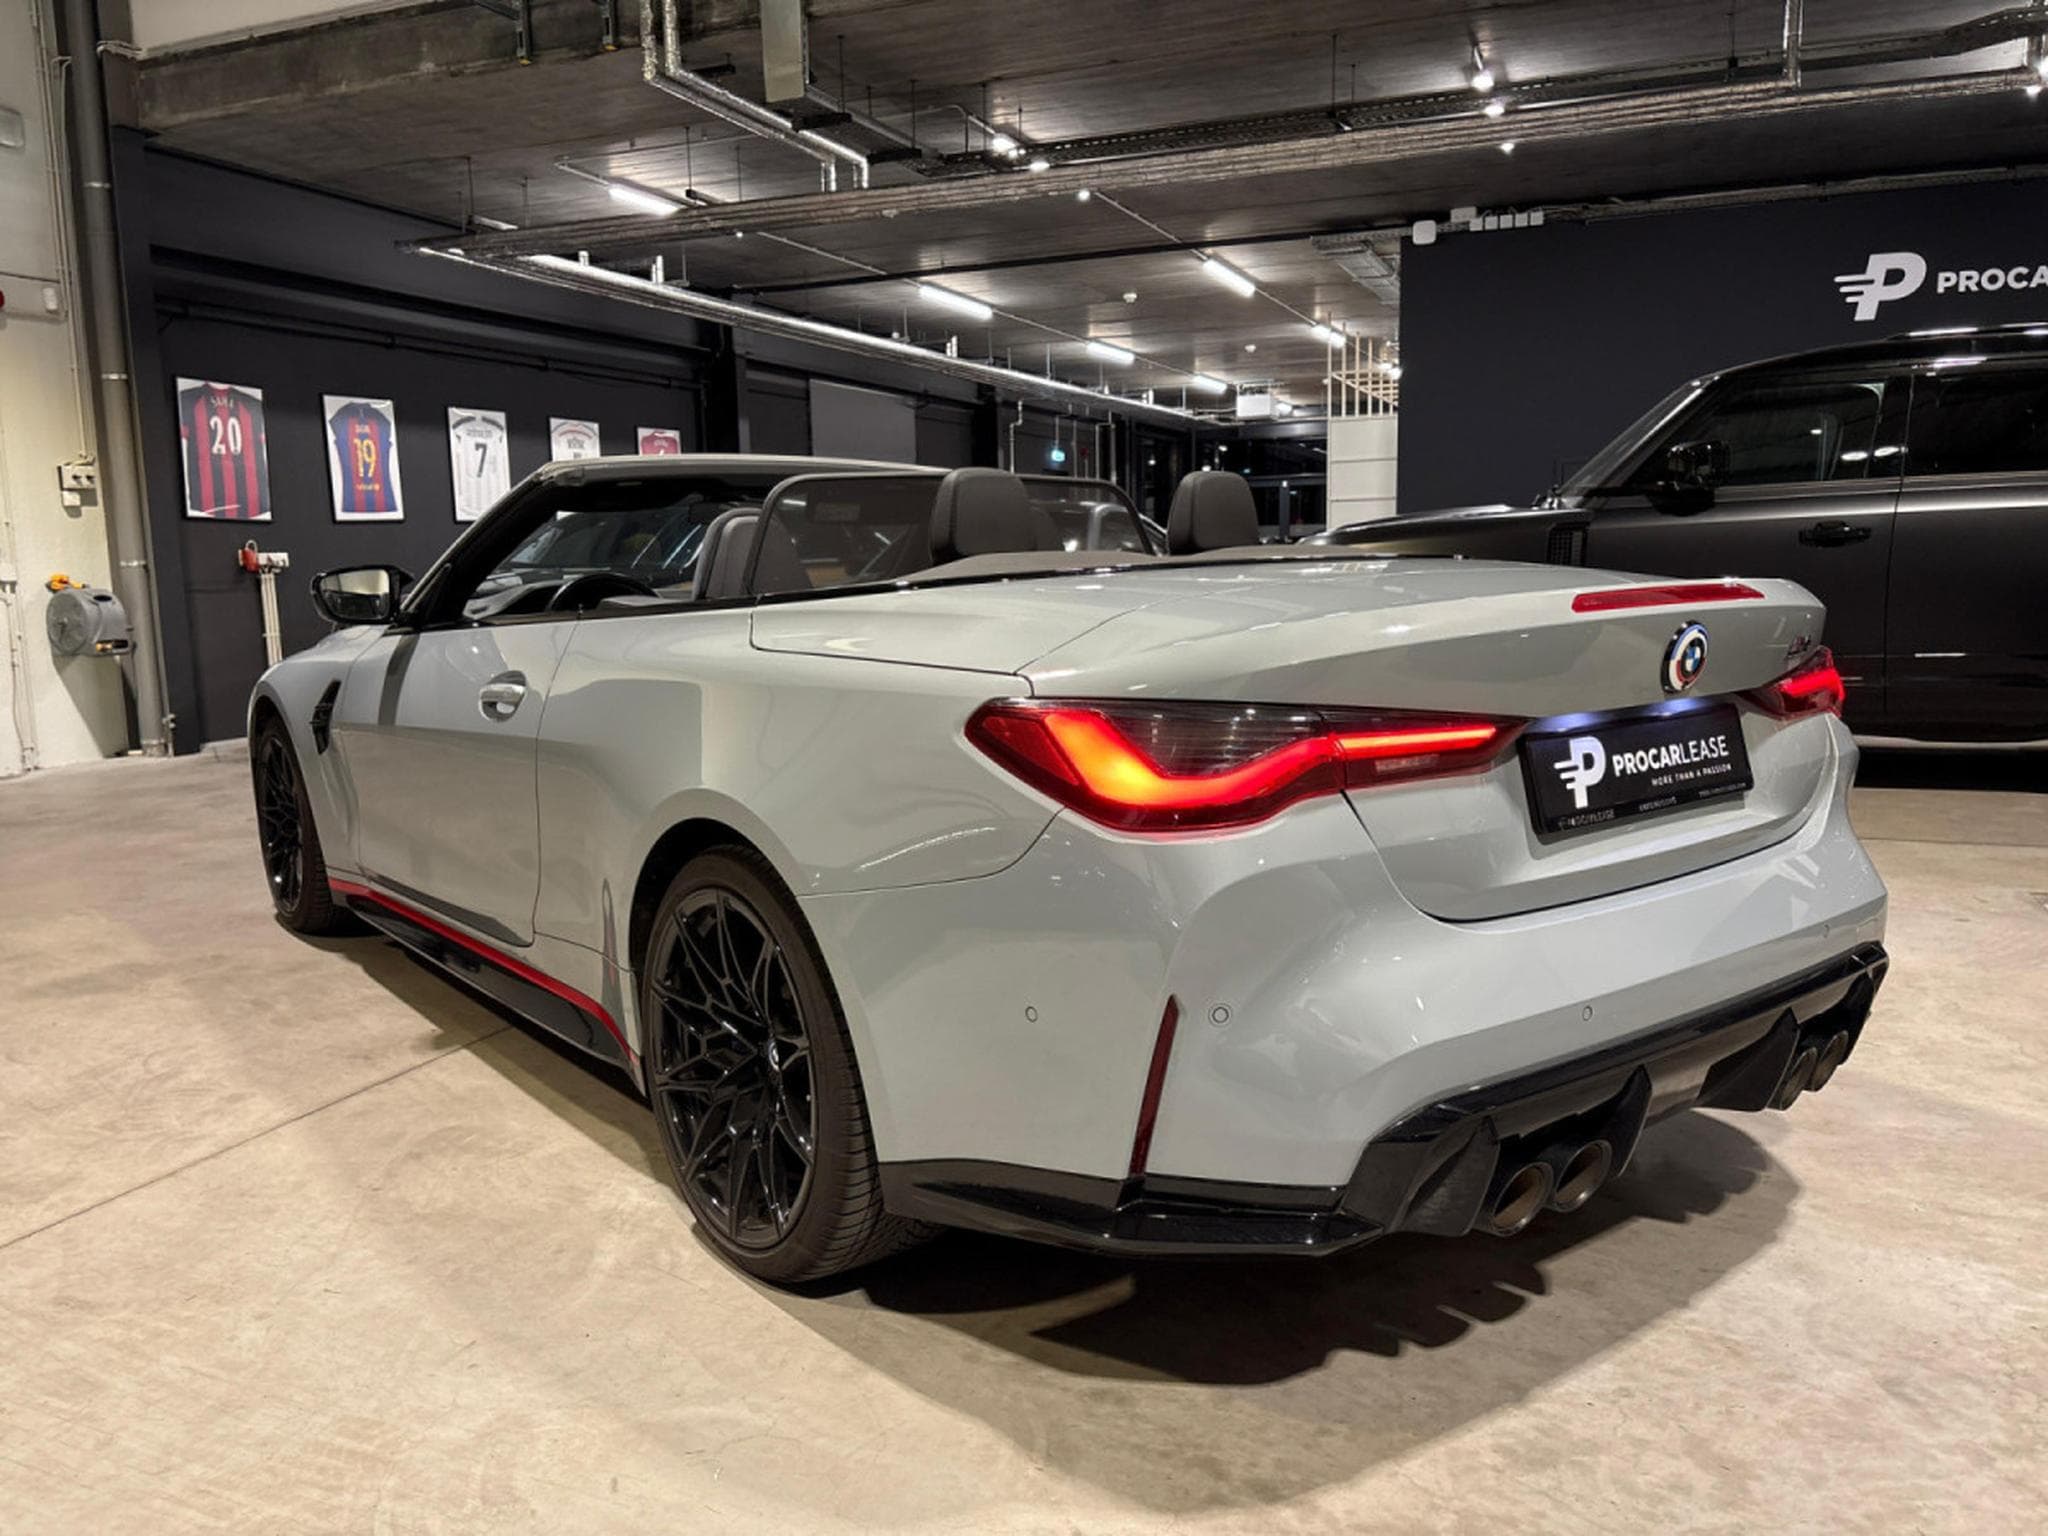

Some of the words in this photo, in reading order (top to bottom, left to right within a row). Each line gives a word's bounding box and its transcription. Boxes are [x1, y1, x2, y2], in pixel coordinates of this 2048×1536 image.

[209, 416, 242, 455] 20
[353, 438, 377, 478] 19
[475, 443, 487, 478] 7
[1612, 735, 1729, 777] PROCARLEASE
[1651, 773, 1673, 786] MORE
[1675, 770, 1694, 781] THAN
[1702, 763, 1732, 776] PASSION
